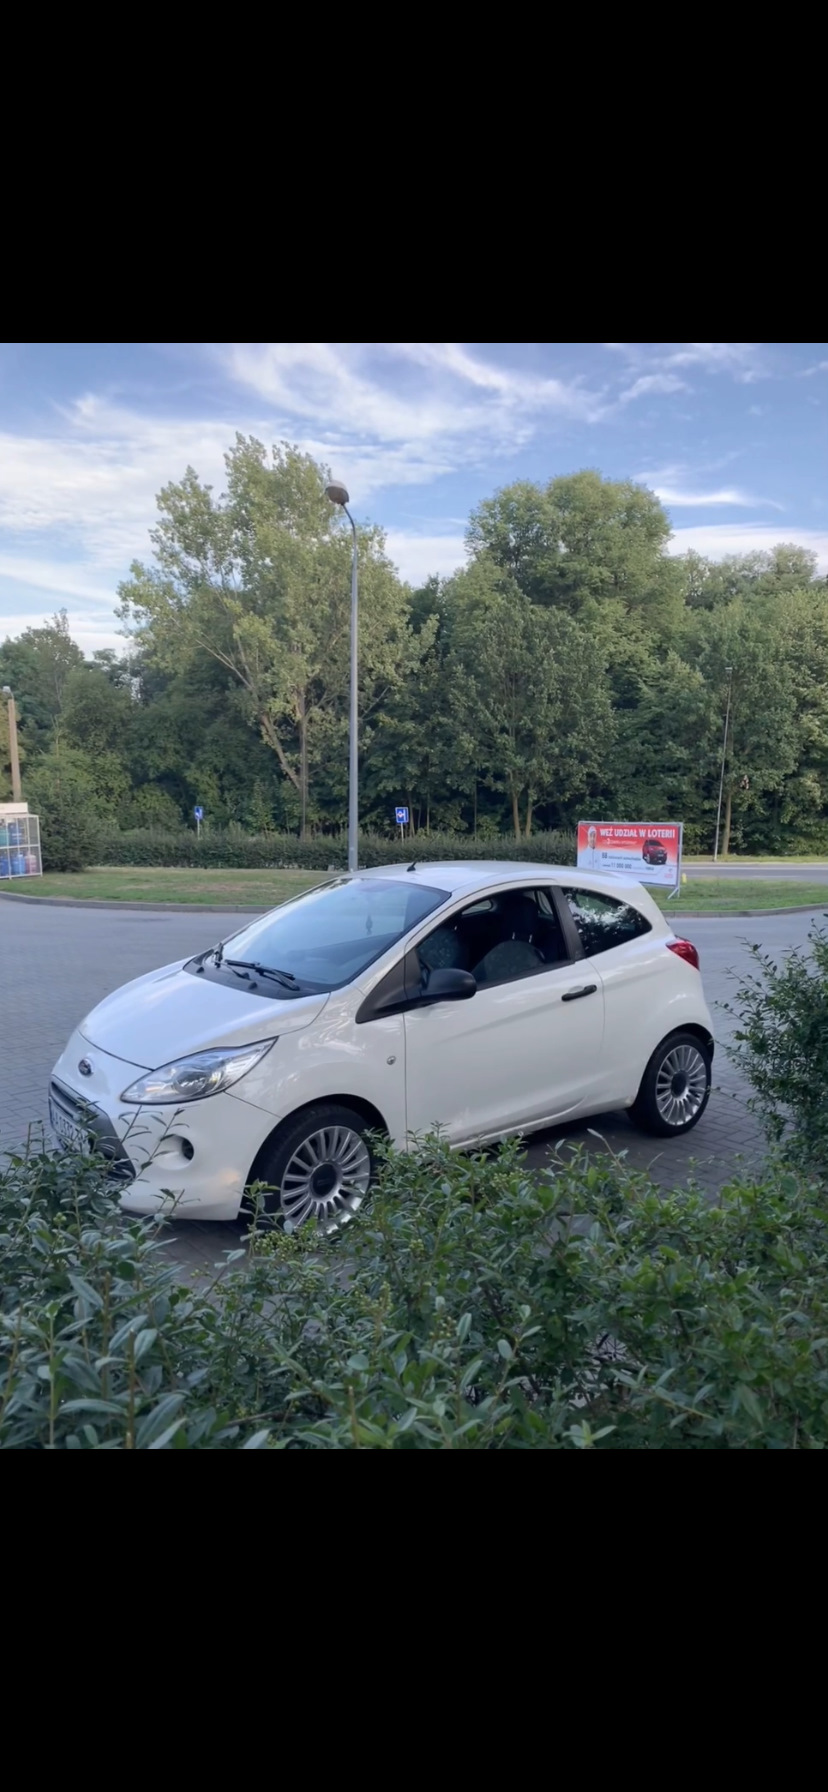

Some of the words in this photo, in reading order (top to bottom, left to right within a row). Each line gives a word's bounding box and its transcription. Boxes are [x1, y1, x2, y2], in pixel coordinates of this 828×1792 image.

[600, 827, 613, 837] WEŹ
[614, 828, 638, 837] UDZIAŁ
[639, 829, 646, 837] W
